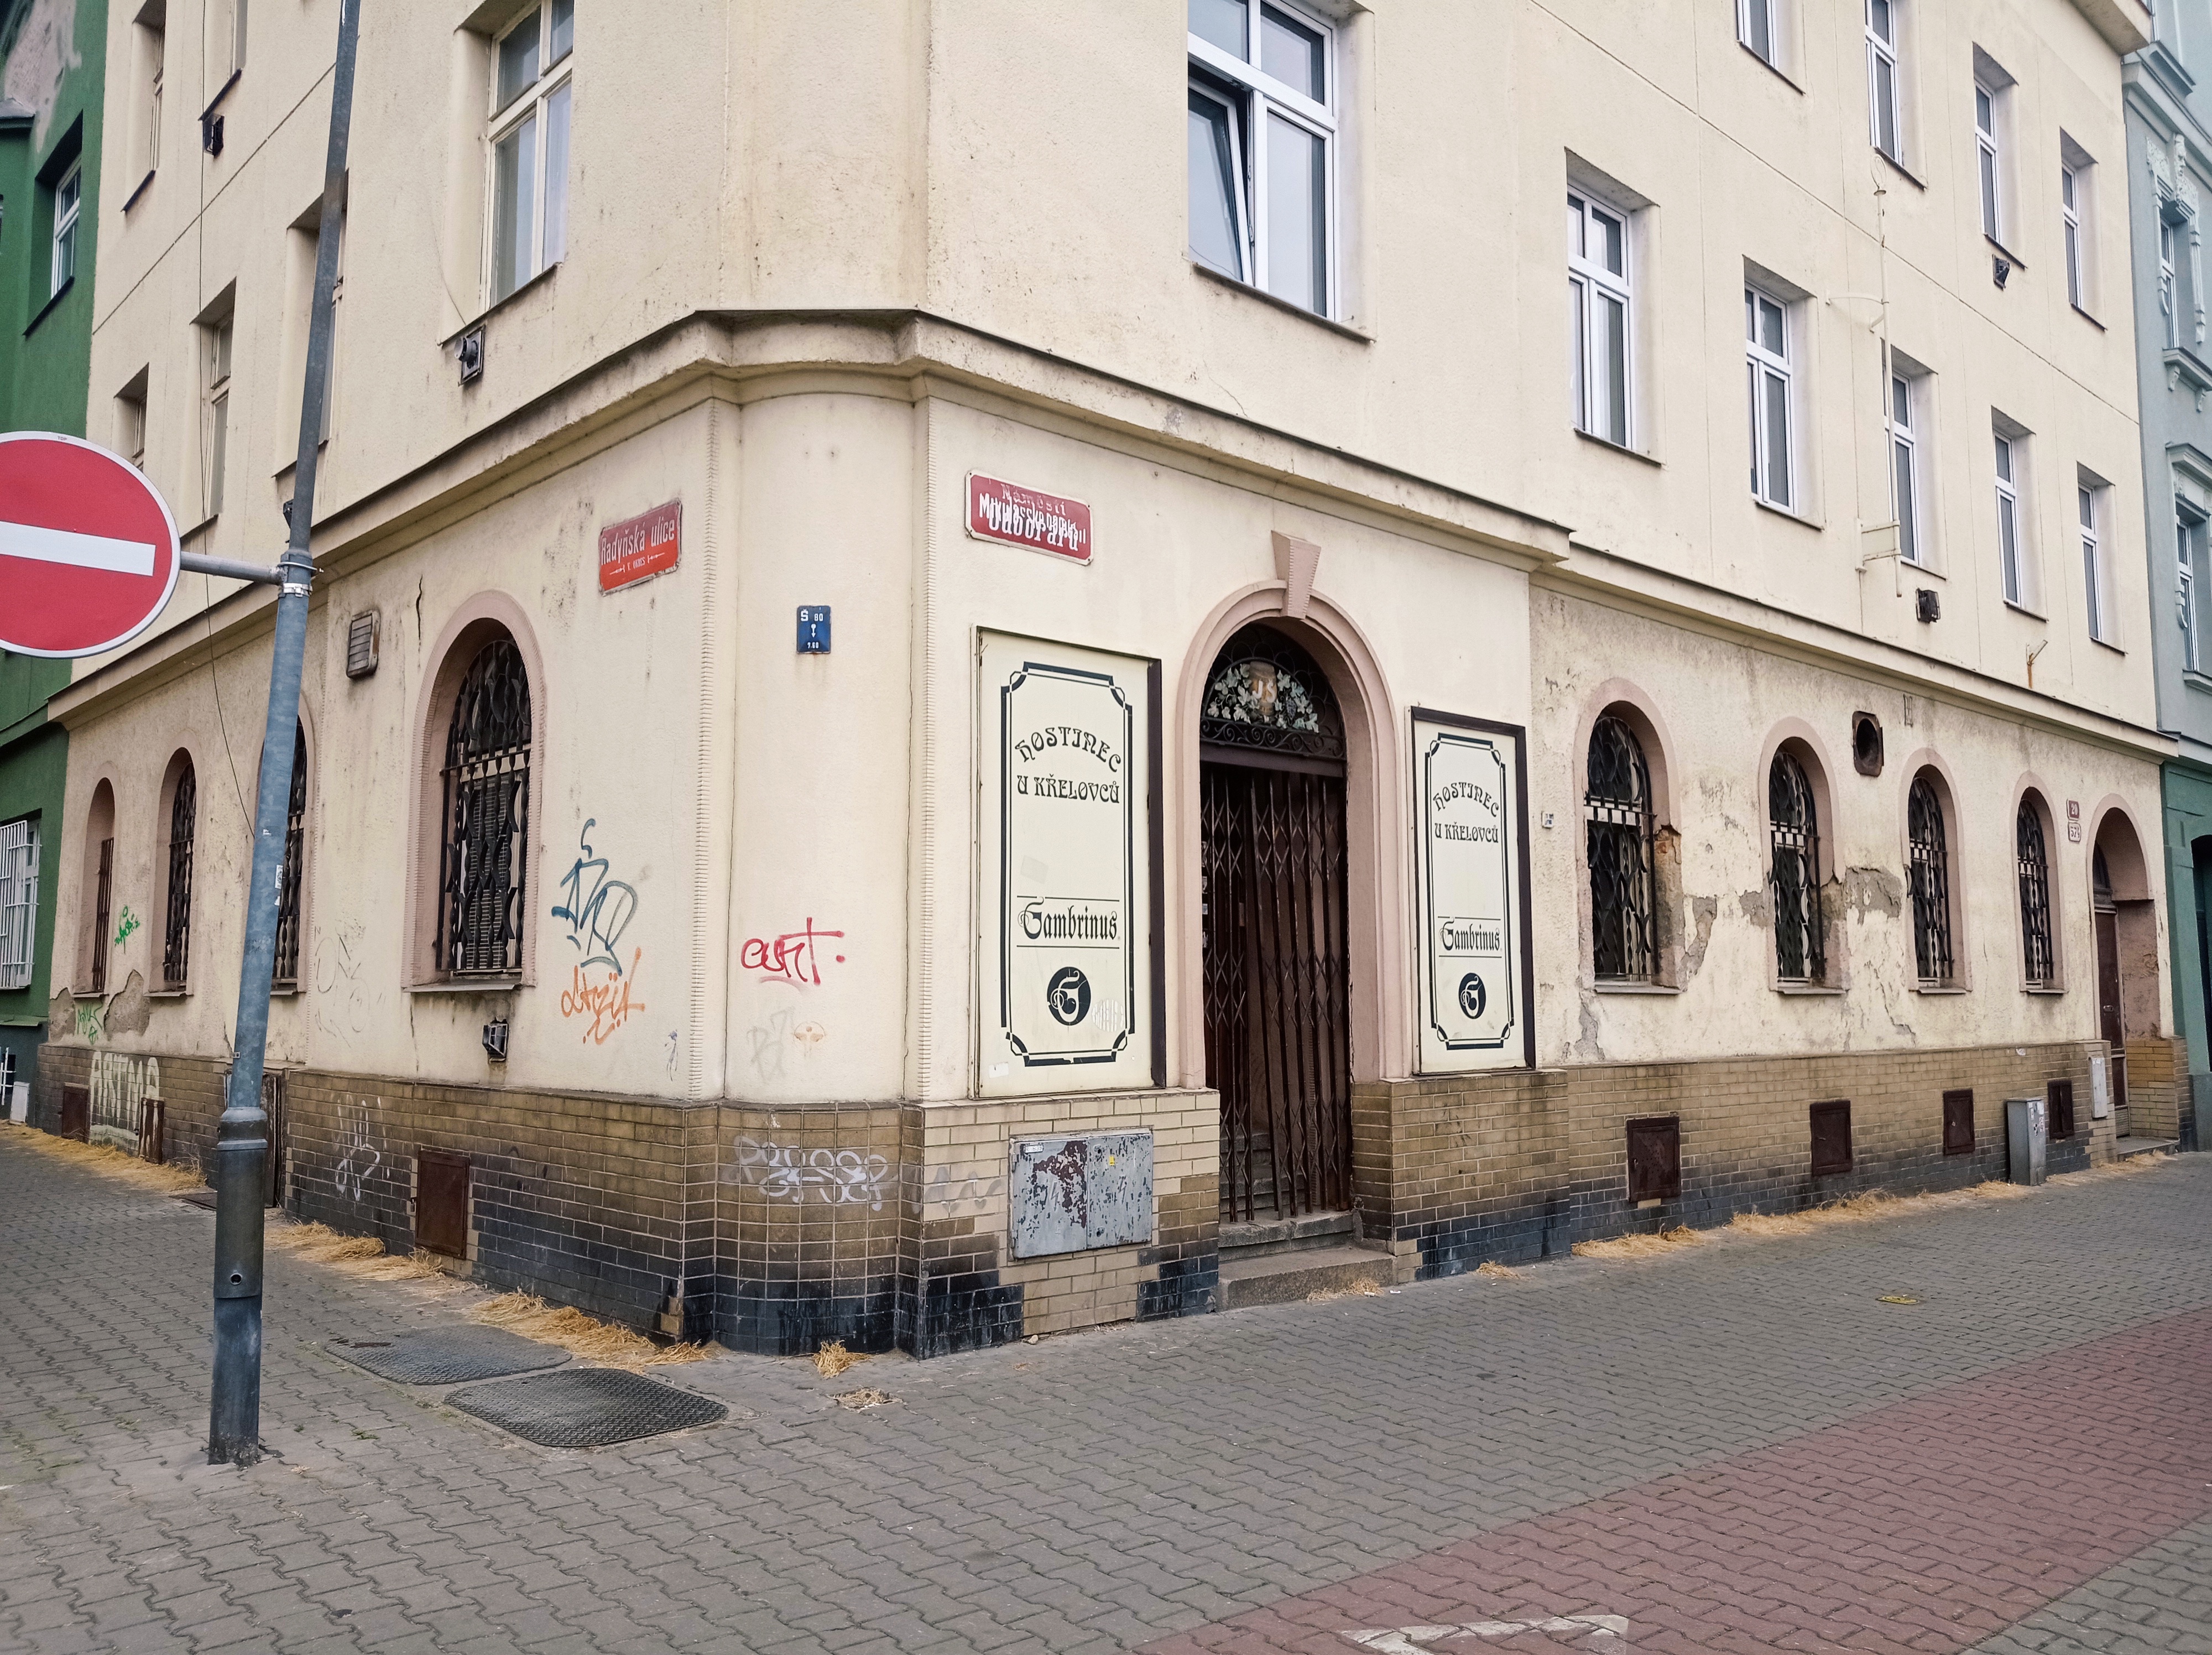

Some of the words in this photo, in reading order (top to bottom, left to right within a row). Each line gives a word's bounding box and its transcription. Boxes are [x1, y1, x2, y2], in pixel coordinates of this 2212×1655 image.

[601, 522, 646, 566] Radyňská
[651, 516, 675, 548] ulice
[814, 613, 824, 622] 80
[1014, 726, 1121, 773] HOSTINEC
[1017, 774, 1029, 795] U
[1034, 773, 1120, 804] KŘELOVCŮ
[1433, 782, 1499, 818] HOSTINEC
[2071, 803, 2078, 815] 20
[1434, 823, 1442, 839] U
[1444, 821, 1499, 843] KŘELOVCŮ
[2070, 826, 2080, 838] 574
[1018, 896, 1118, 940] Gambrinus
[1439, 917, 1500, 951] Gambrinus
